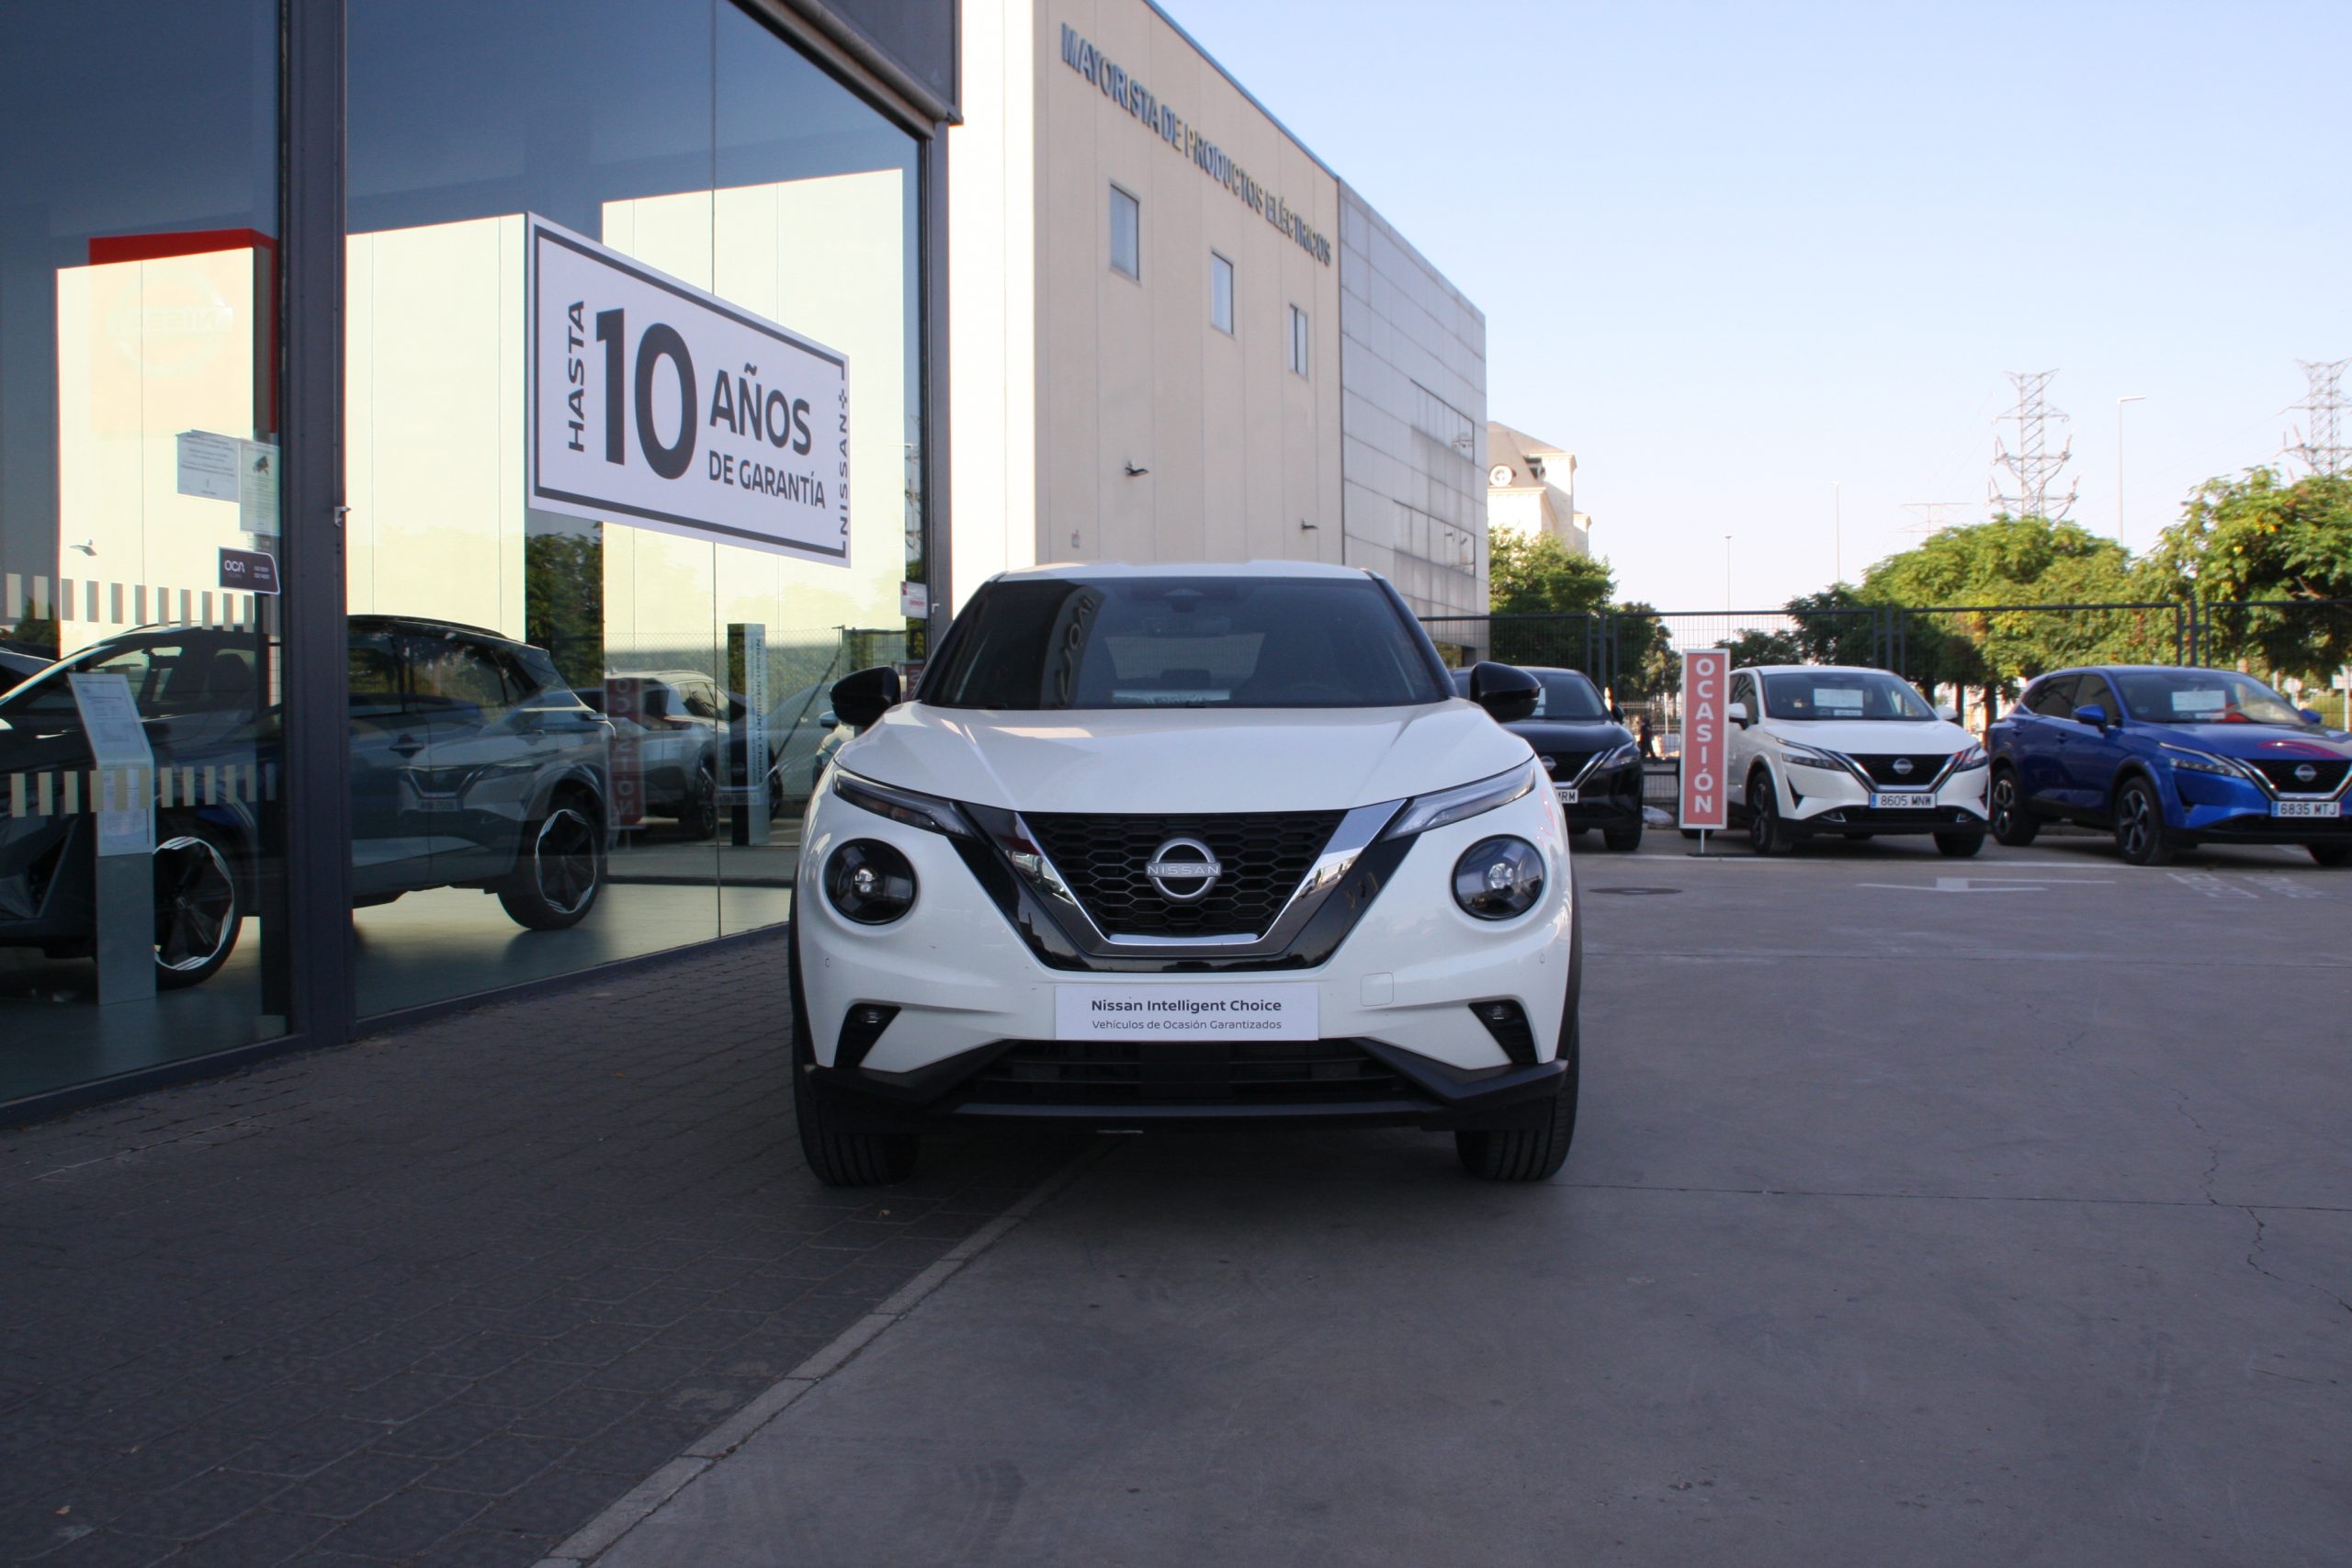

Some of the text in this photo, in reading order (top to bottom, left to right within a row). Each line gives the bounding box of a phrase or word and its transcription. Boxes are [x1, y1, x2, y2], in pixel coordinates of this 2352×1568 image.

[1061, 22, 1331, 266] MAYORISTA DE PRODUCTOS ELÉCTRICOS
[568, 300, 584, 452] HASTA
[595, 308, 698, 479] 10
[709, 362, 812, 457] AÑOS
[709, 449, 826, 510] DE GARANTÍA
[839, 413, 848, 536] NISSAN
[1694, 658, 1716, 813] OCASIÓN
[1881, 795, 1908, 807] 8605
[2280, 803, 2336, 815] 6835 MTJ
[1148, 865, 1219, 874] NISSAN
[1091, 998, 1283, 1014] Nissan Intelligent Choice
[1091, 1020, 1283, 1030] Vehículos de Ocasión Garantizados
